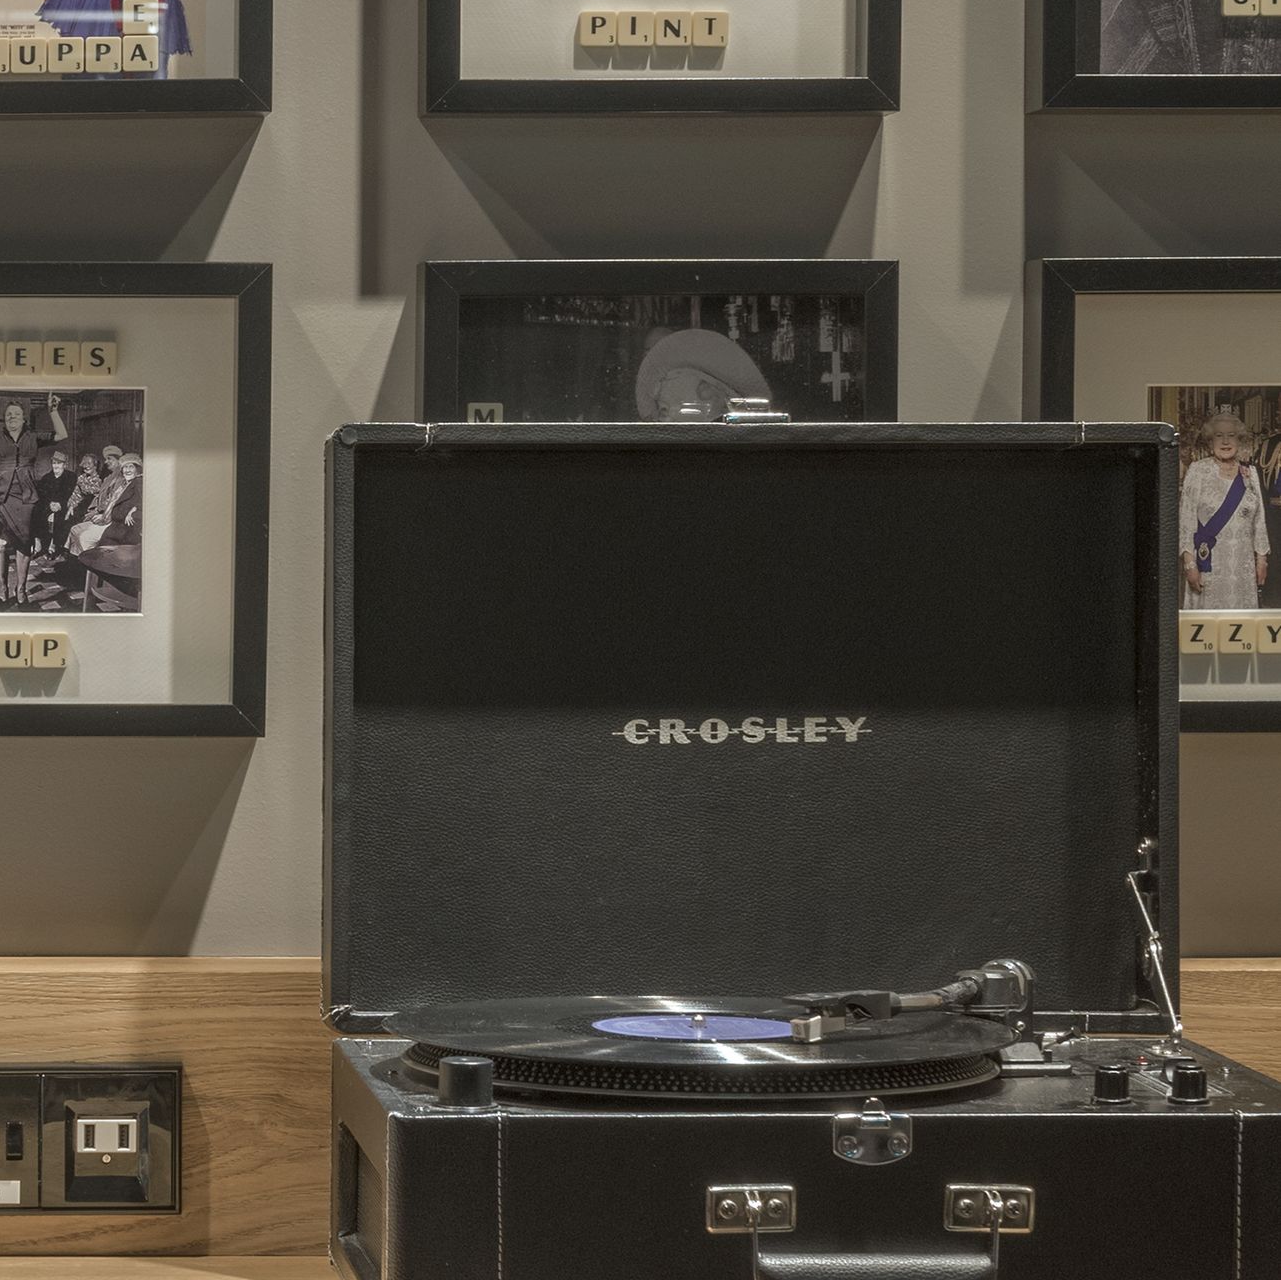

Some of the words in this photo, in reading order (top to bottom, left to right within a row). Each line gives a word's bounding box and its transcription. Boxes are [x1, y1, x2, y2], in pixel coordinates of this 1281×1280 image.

[590, 15, 724, 43] PINT
[4, 639, 66, 666] UP
[618, 716, 869, 745] CROSLEY
